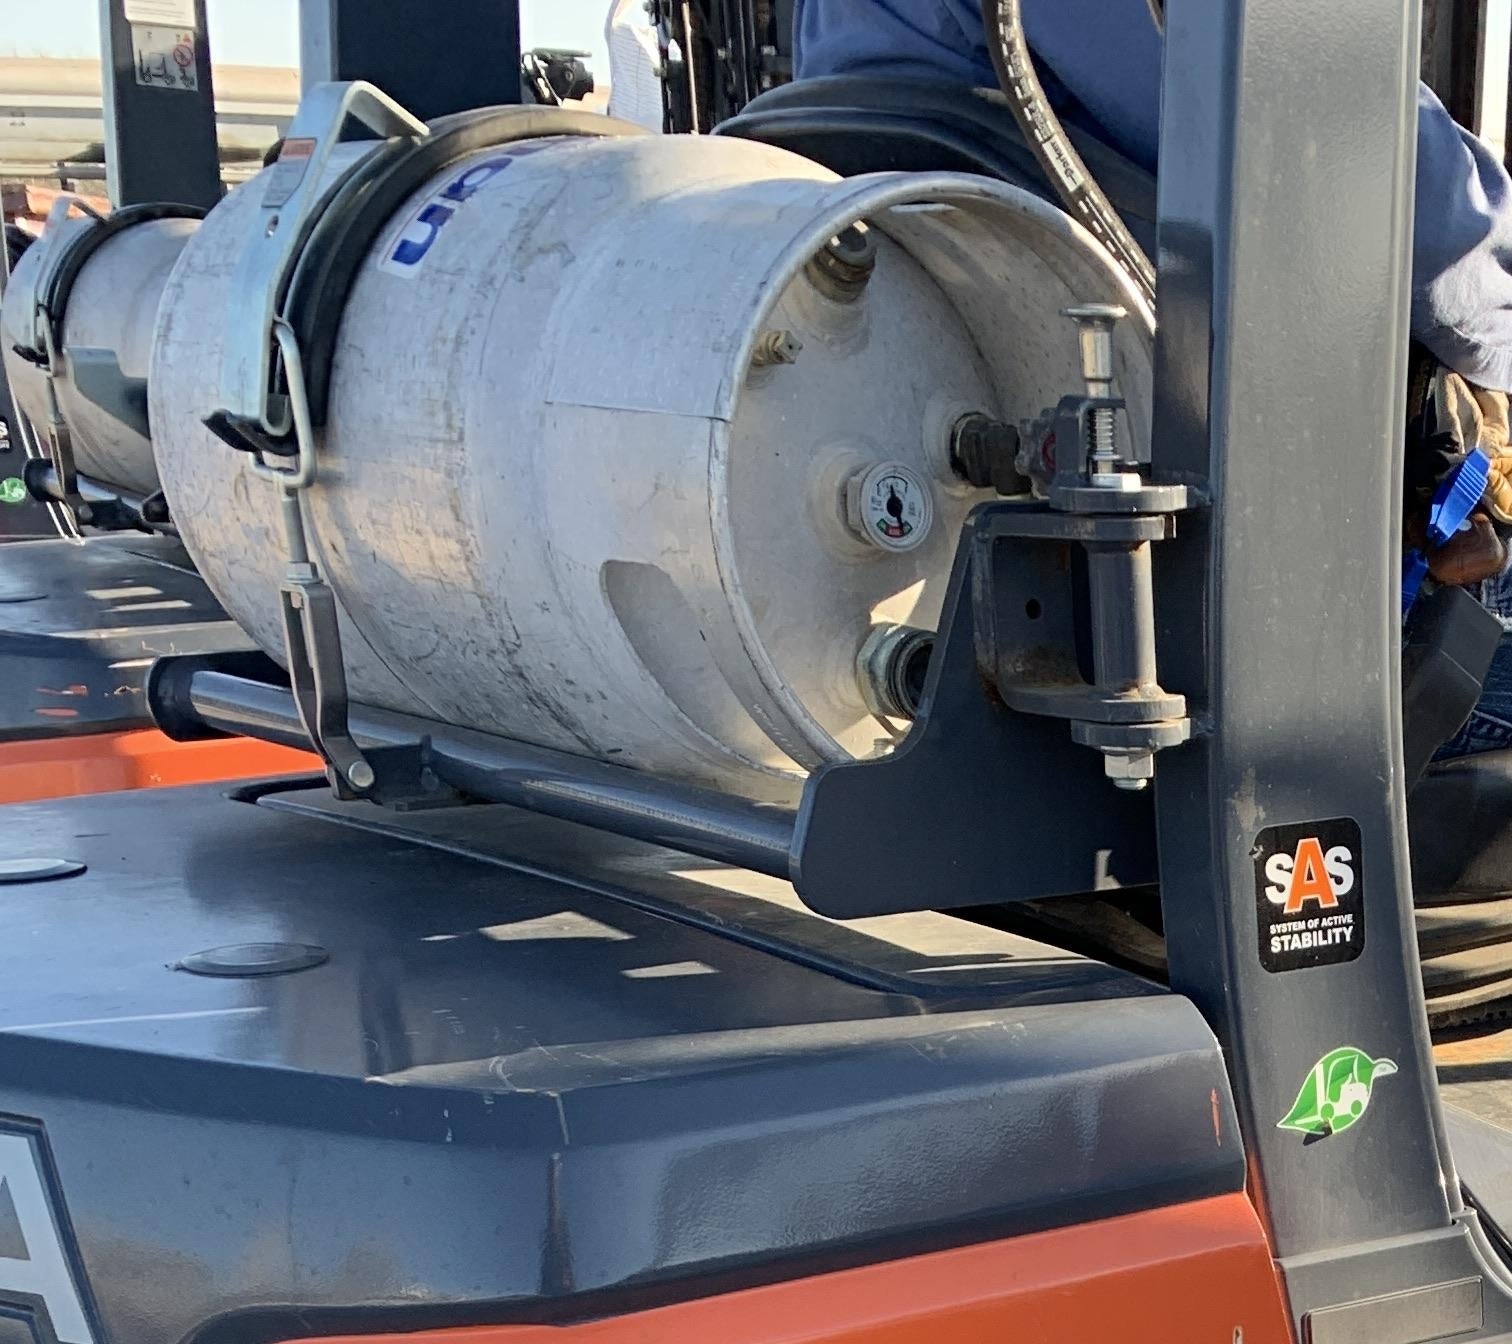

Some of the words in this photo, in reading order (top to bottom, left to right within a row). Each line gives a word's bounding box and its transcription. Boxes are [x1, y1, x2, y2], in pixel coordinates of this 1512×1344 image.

[1264, 837, 1355, 914] SAS
[1269, 919, 1306, 934] SYSTEM
[1307, 917, 1320, 929] OF
[1321, 914, 1354, 926] ACTIVE
[1270, 926, 1354, 953] STABILITY
